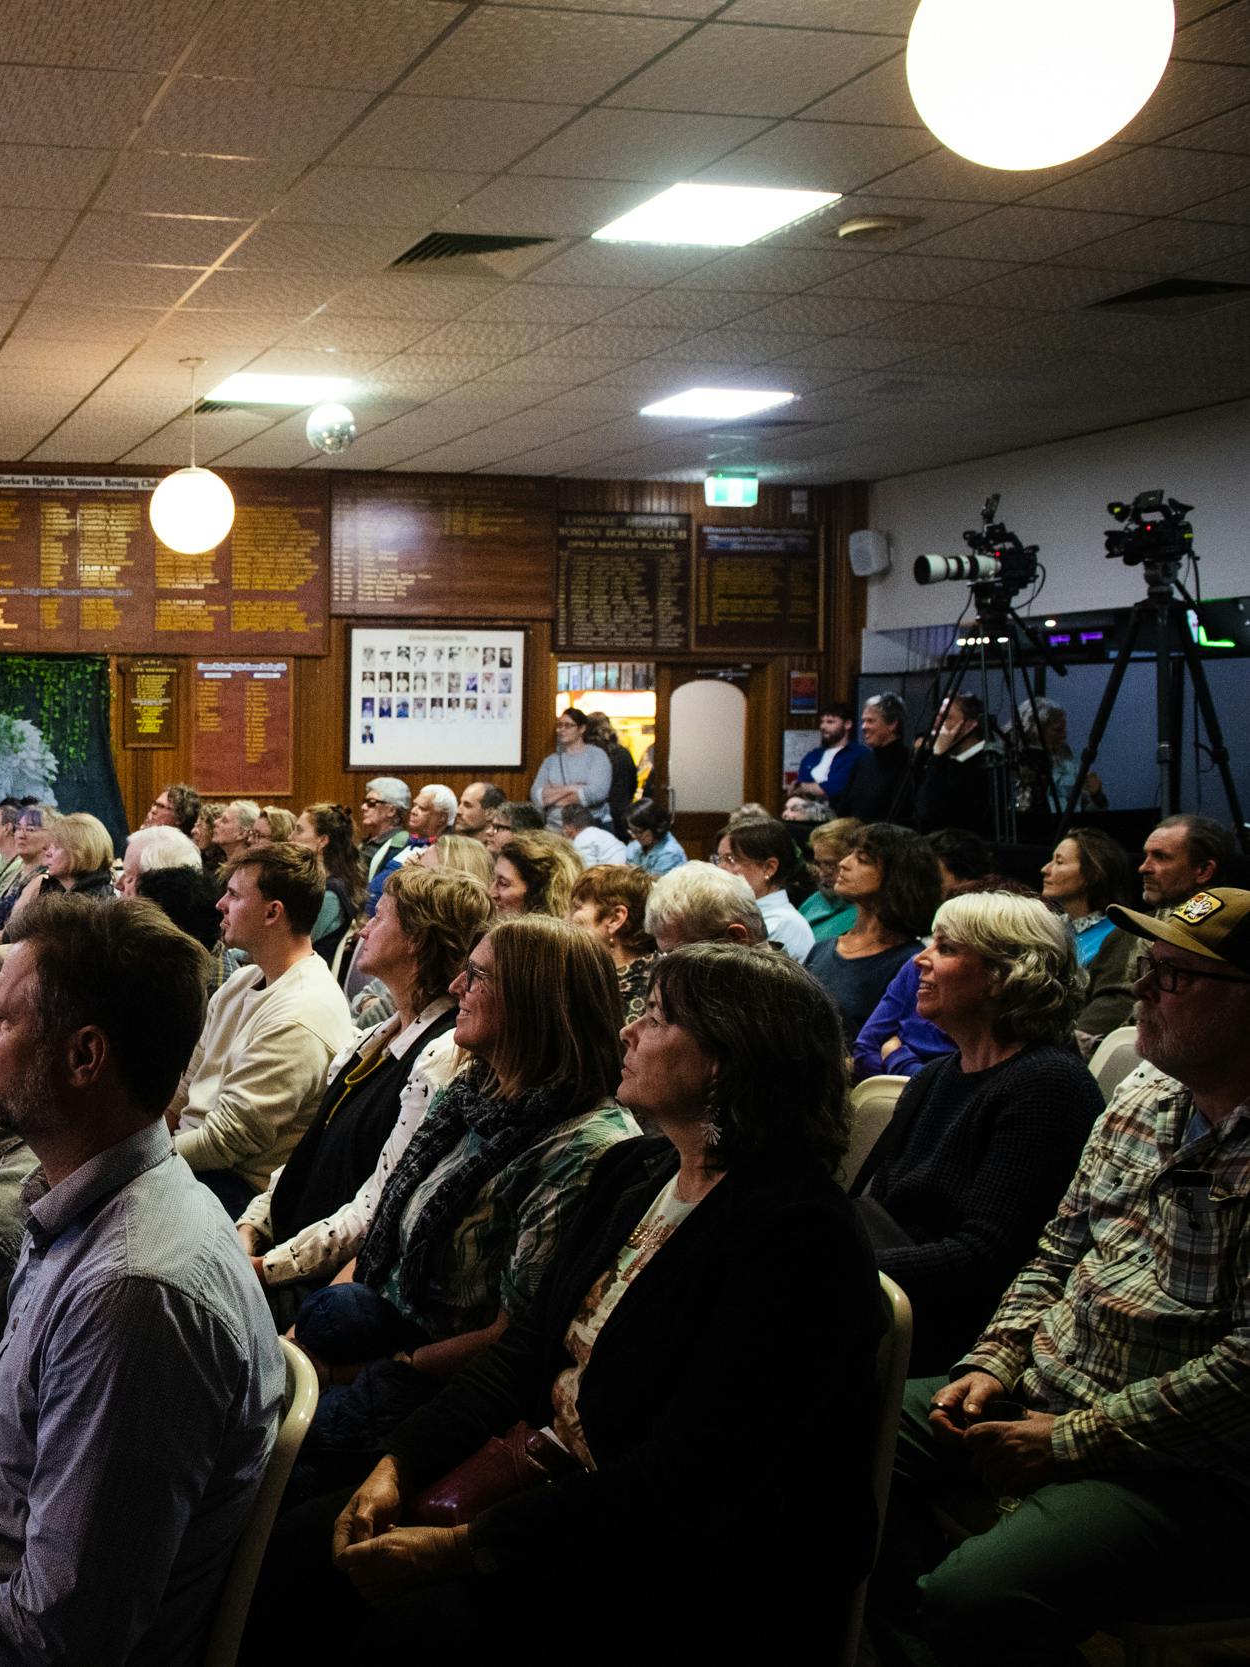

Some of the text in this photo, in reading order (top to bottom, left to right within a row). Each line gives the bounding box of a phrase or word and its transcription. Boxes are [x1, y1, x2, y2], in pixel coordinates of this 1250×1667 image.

[32, 477, 64, 488] Heights
[67, 478, 102, 487] Womens
[105, 479, 138, 489] Bowling
